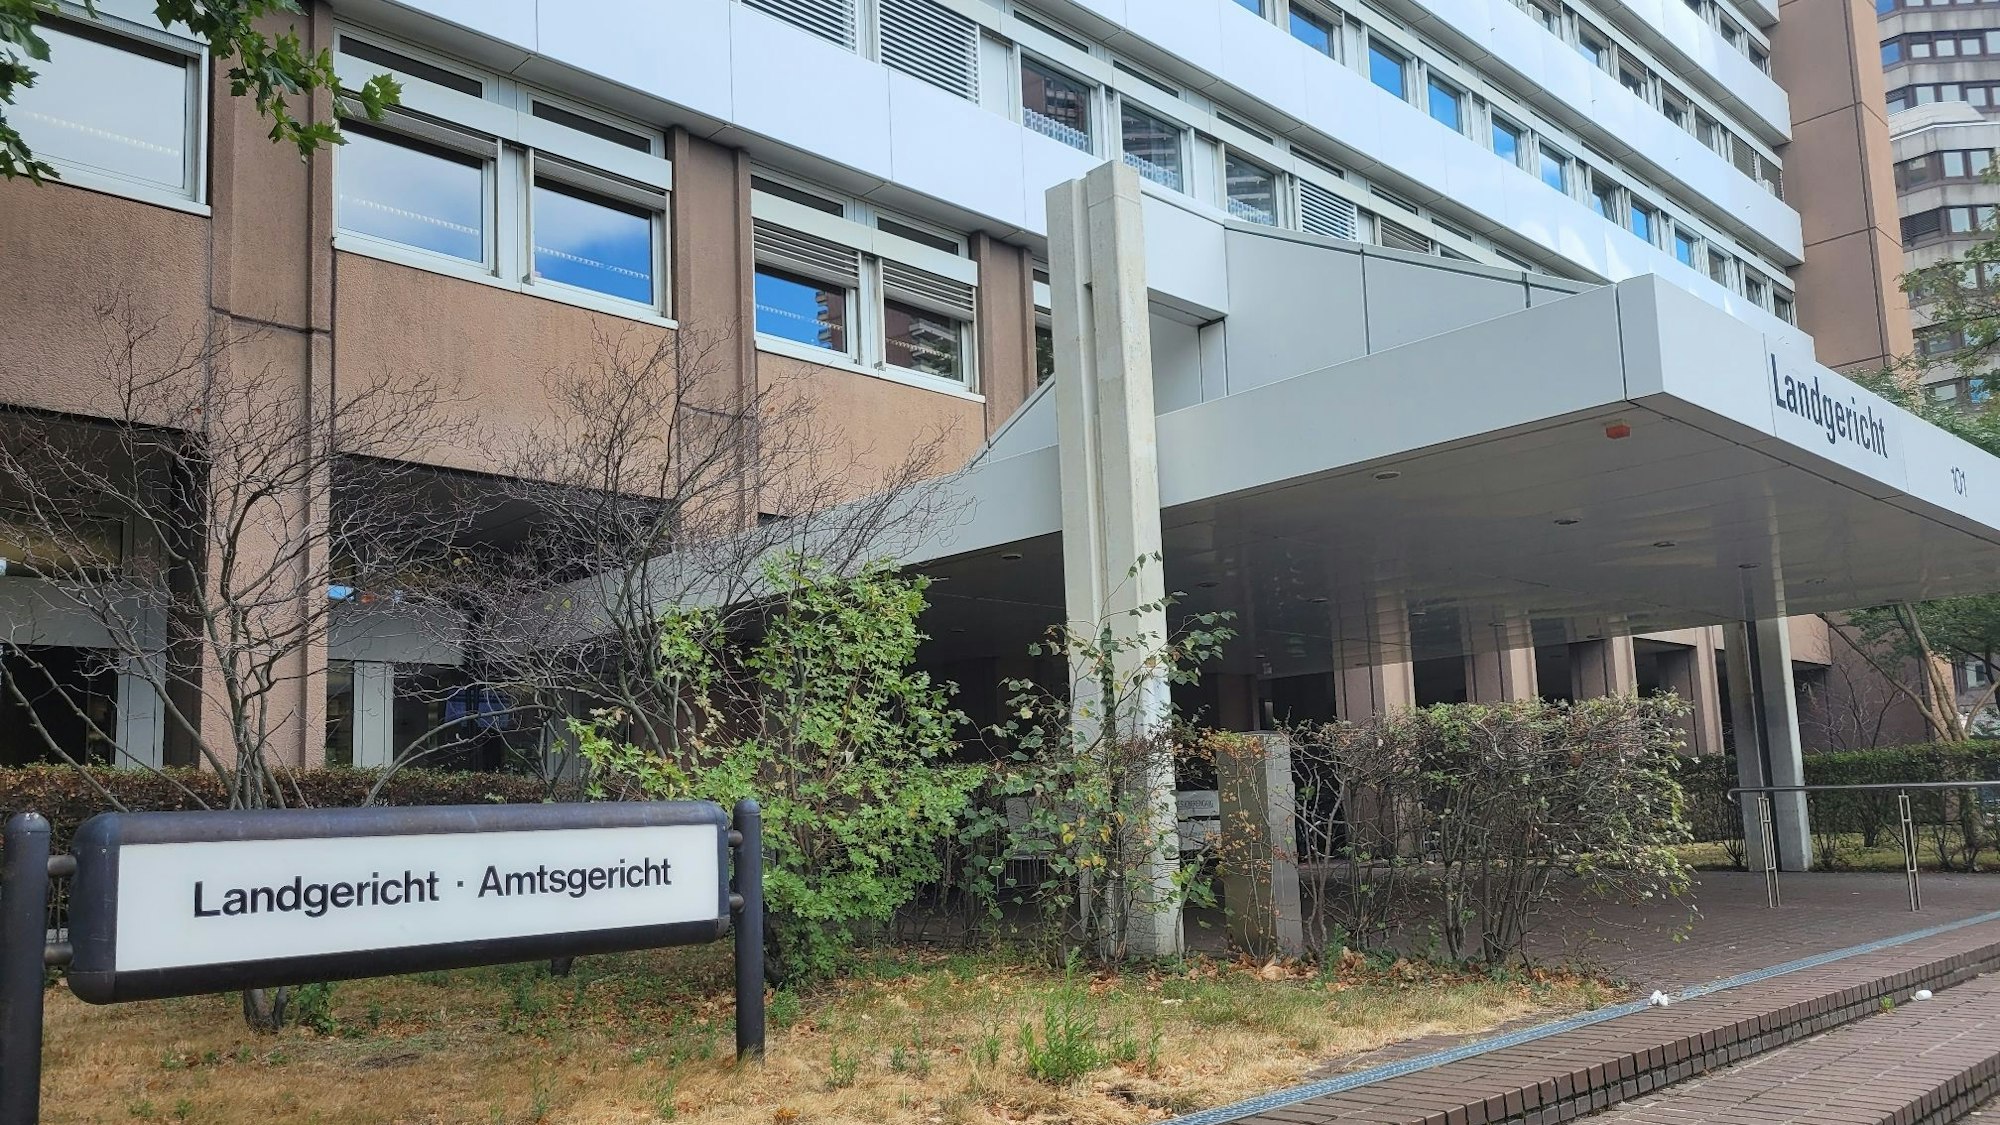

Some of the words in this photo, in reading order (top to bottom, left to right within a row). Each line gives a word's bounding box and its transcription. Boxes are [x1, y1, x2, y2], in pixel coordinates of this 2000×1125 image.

[1770, 353, 1888, 459] Landgericht
[1951, 466, 1968, 498] 101
[194, 869, 440, 918] Landgericht
[477, 857, 672, 899] Amtsgericht
